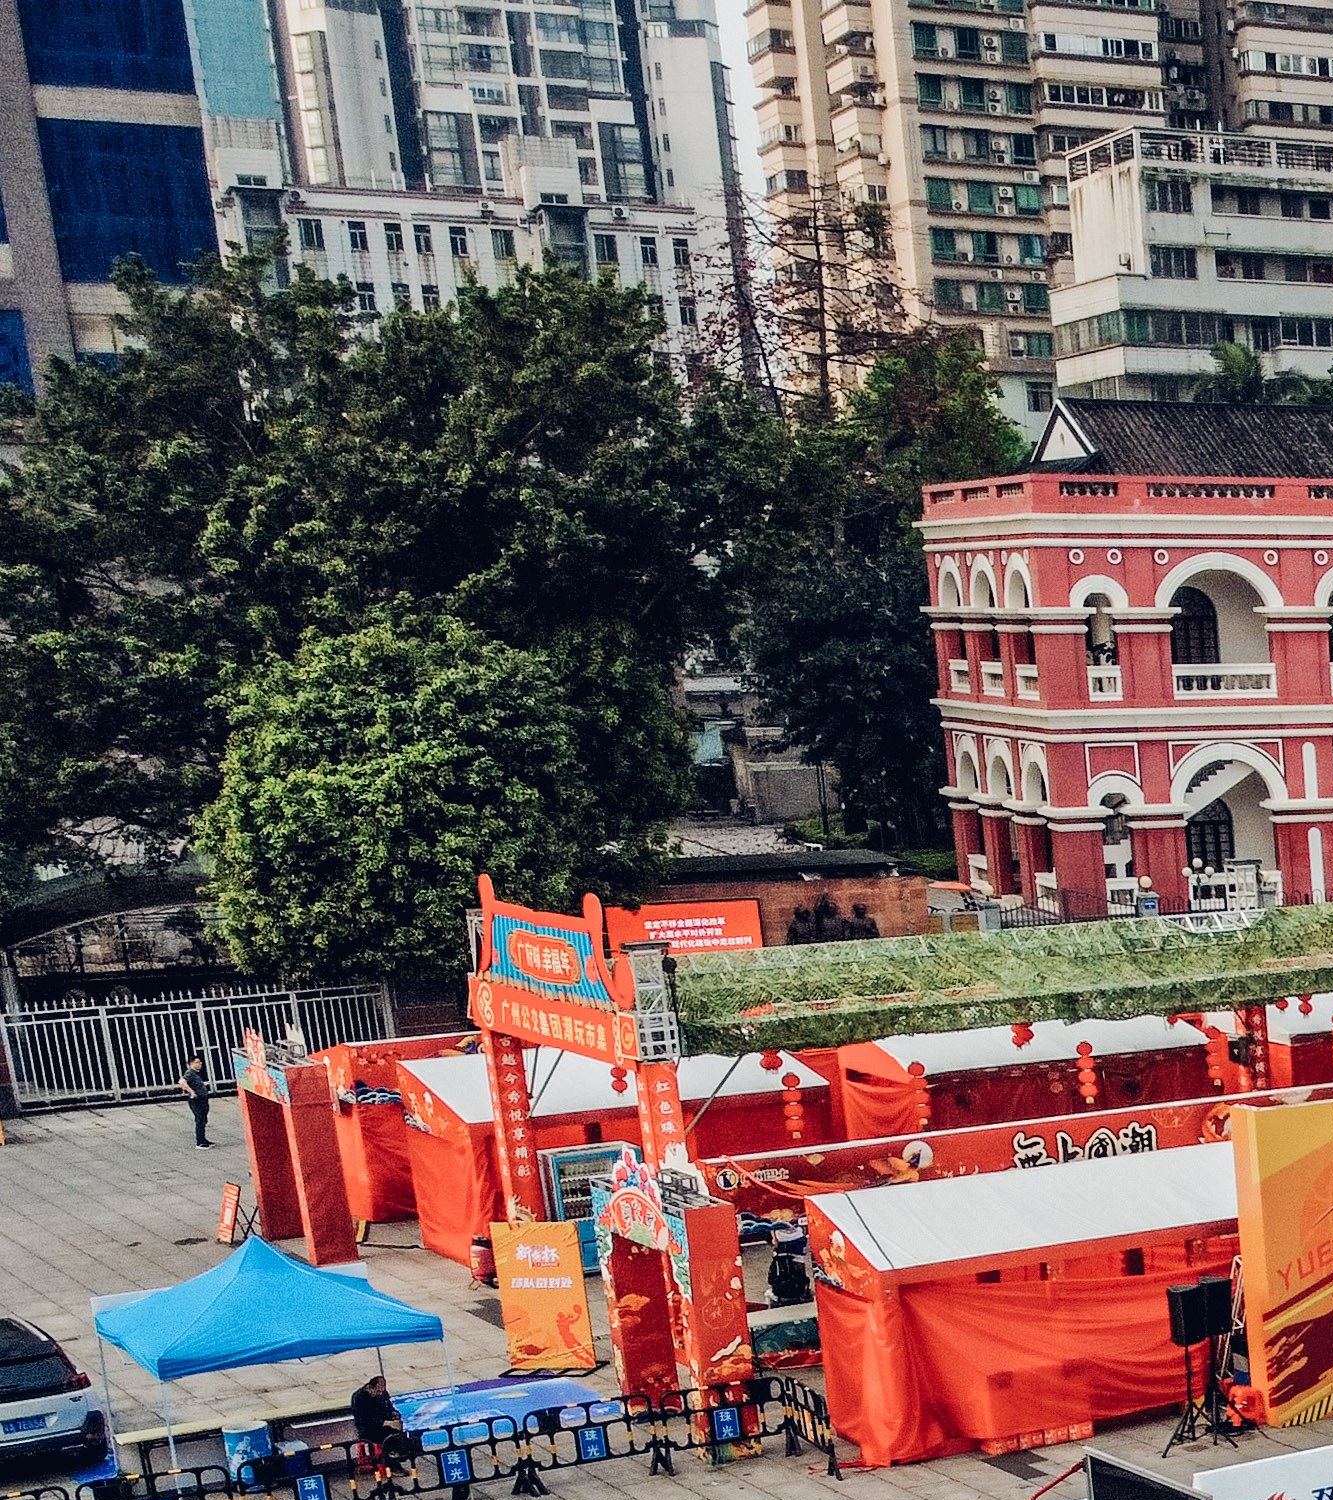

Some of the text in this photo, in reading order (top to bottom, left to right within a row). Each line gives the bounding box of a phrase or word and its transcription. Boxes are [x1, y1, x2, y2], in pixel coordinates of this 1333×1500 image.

[501, 1000, 607, 1052] 广州公交集团潮玩市集
[719, 1410, 734, 1438] 珠光
[583, 1428, 599, 1456] 珠光
[446, 1451, 465, 1480] 珠光
